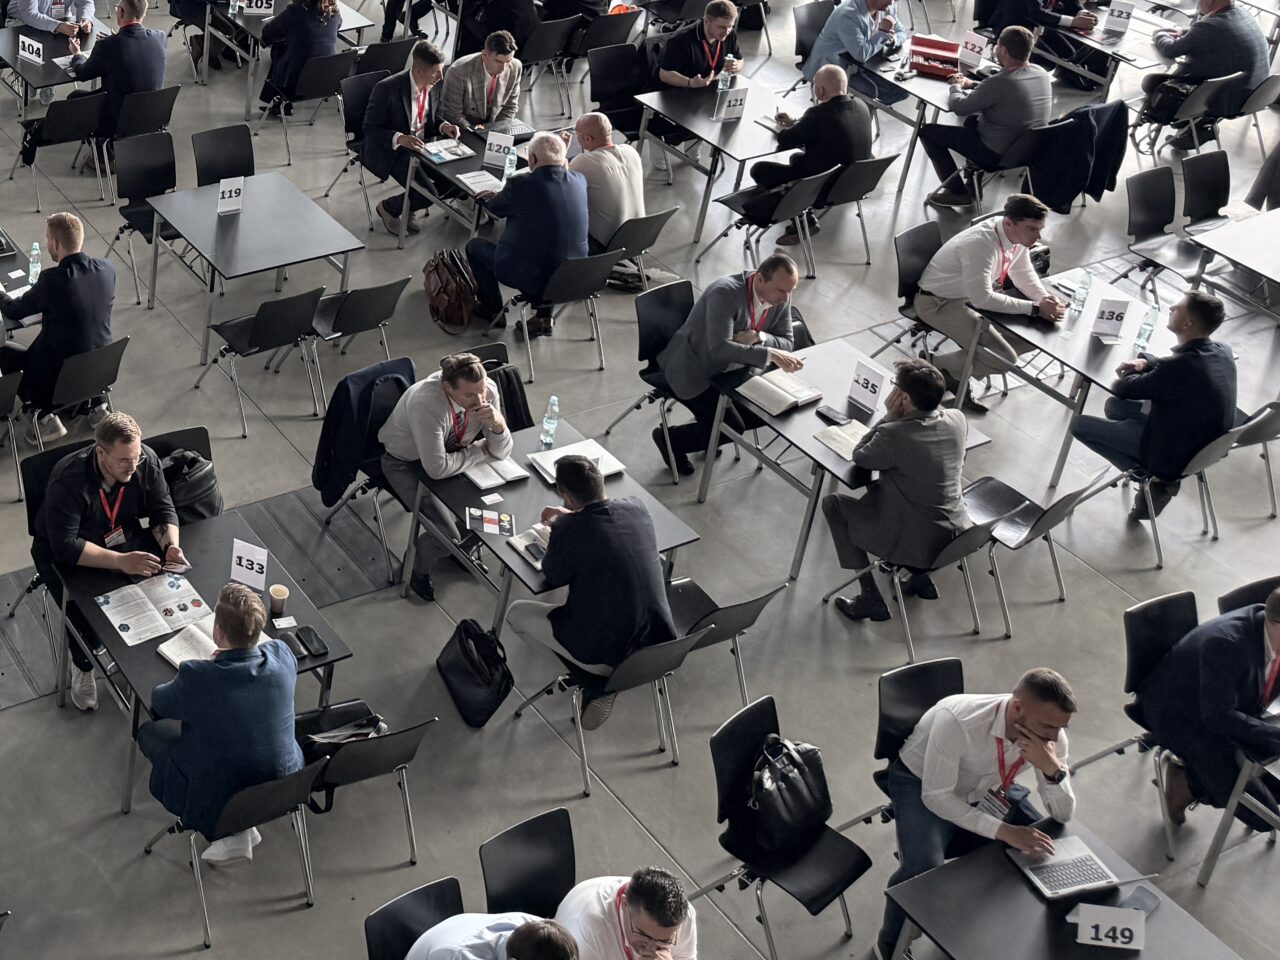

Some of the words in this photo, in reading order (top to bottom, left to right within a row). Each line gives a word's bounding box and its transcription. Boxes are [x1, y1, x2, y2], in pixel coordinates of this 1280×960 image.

[1110, 8, 1132, 20] 123
[20, 40, 42, 58] 104
[963, 41, 983, 56] 122
[726, 98, 744, 108] 121
[486, 142, 510, 156] 120
[220, 188, 241, 200] 119
[1097, 310, 1124, 322] 136
[853, 372, 879, 396] 135
[234, 554, 266, 576] 133
[1089, 923, 1135, 946] 149
